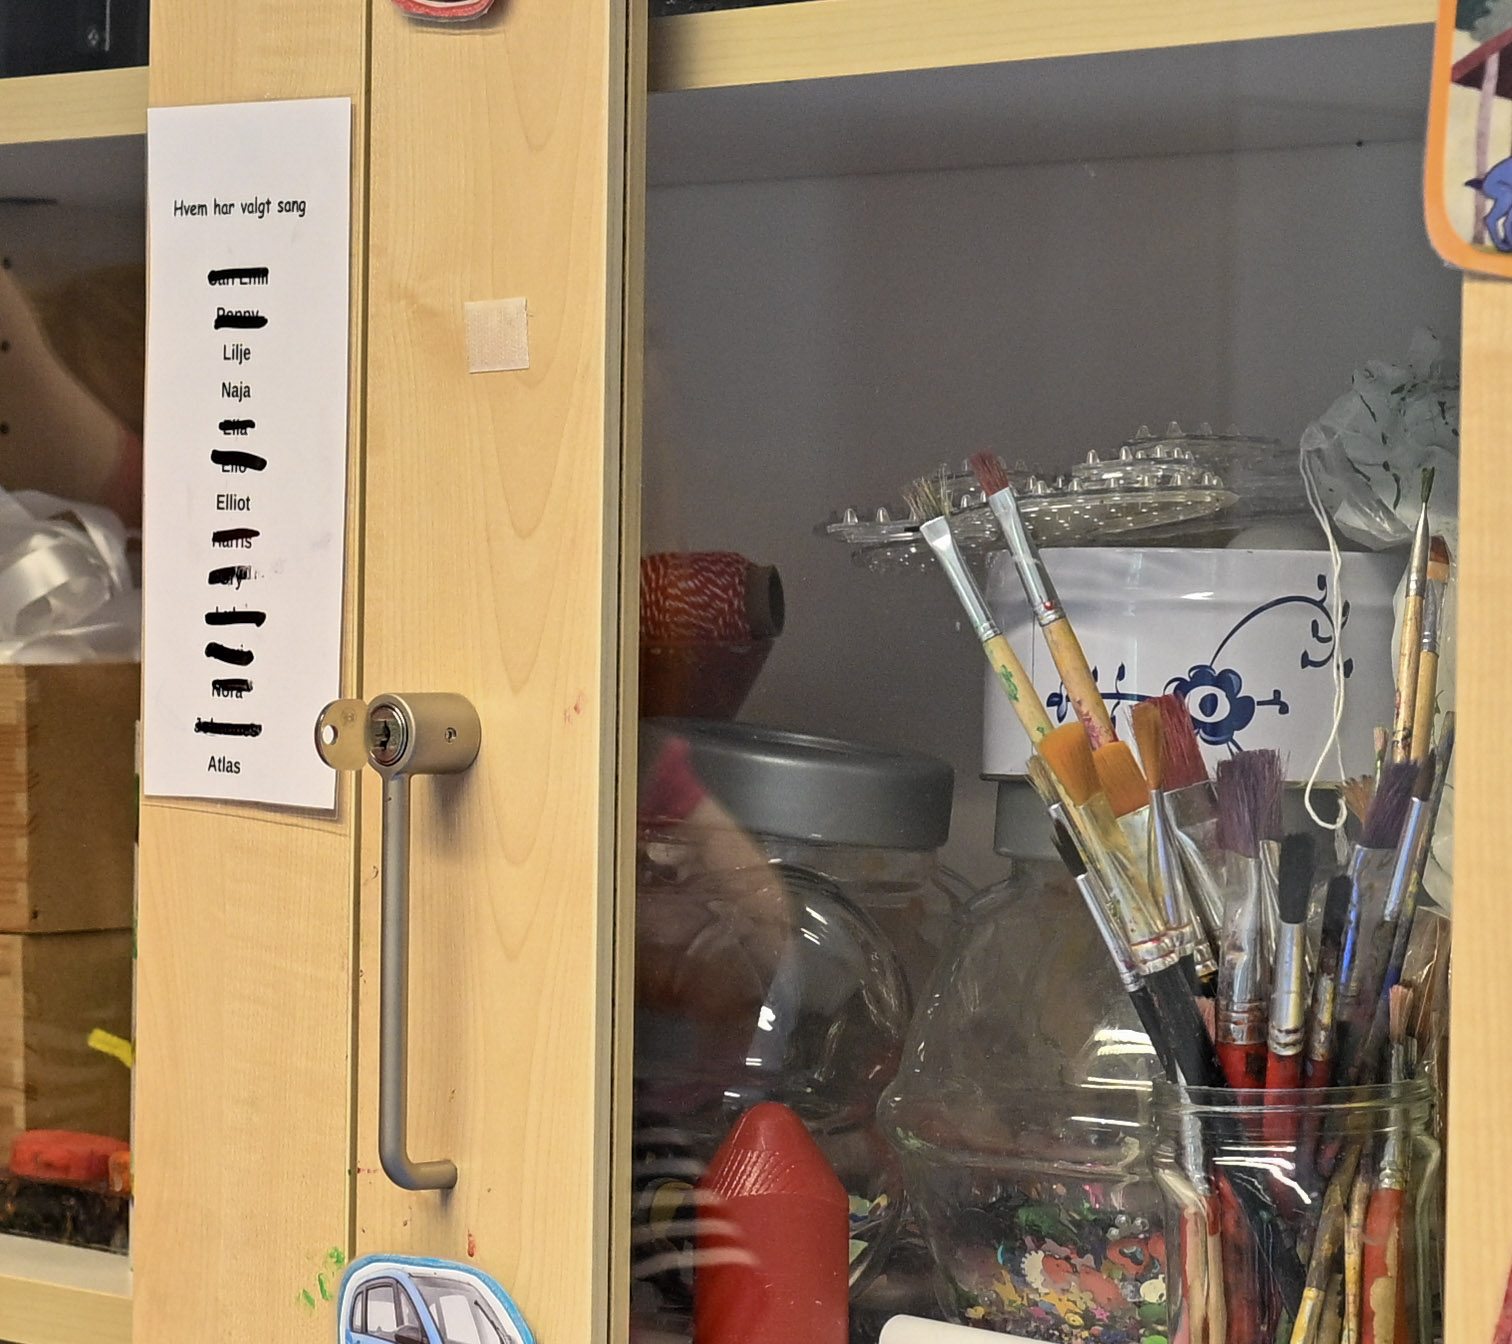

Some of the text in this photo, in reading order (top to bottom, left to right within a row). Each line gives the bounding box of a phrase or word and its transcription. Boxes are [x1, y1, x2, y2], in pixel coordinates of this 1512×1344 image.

[173, 196, 307, 219] Hvem har valgt sang
[223, 343, 251, 365] Lilje
[221, 381, 251, 402] Naja
[216, 493, 251, 511] Elliot
[207, 755, 241, 774] Atlas
